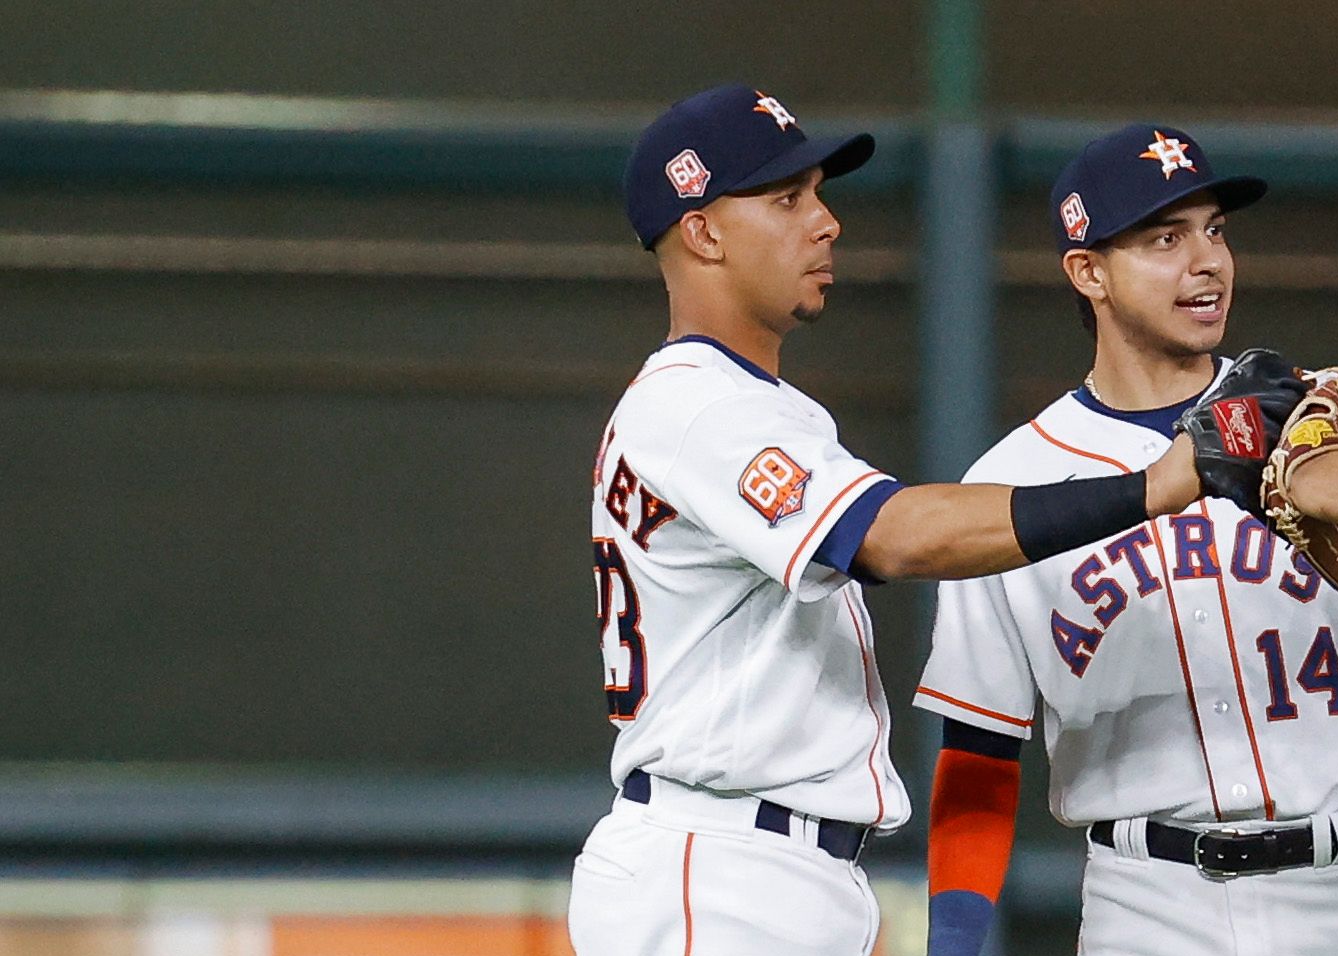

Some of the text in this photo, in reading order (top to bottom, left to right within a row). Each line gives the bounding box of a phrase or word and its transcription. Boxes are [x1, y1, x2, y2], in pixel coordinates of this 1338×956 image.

[670, 154, 701, 186] 60
[1063, 197, 1084, 229] 60
[594, 424, 679, 553] EY
[743, 452, 794, 508] 60
[1050, 514, 1322, 678] ASTROS
